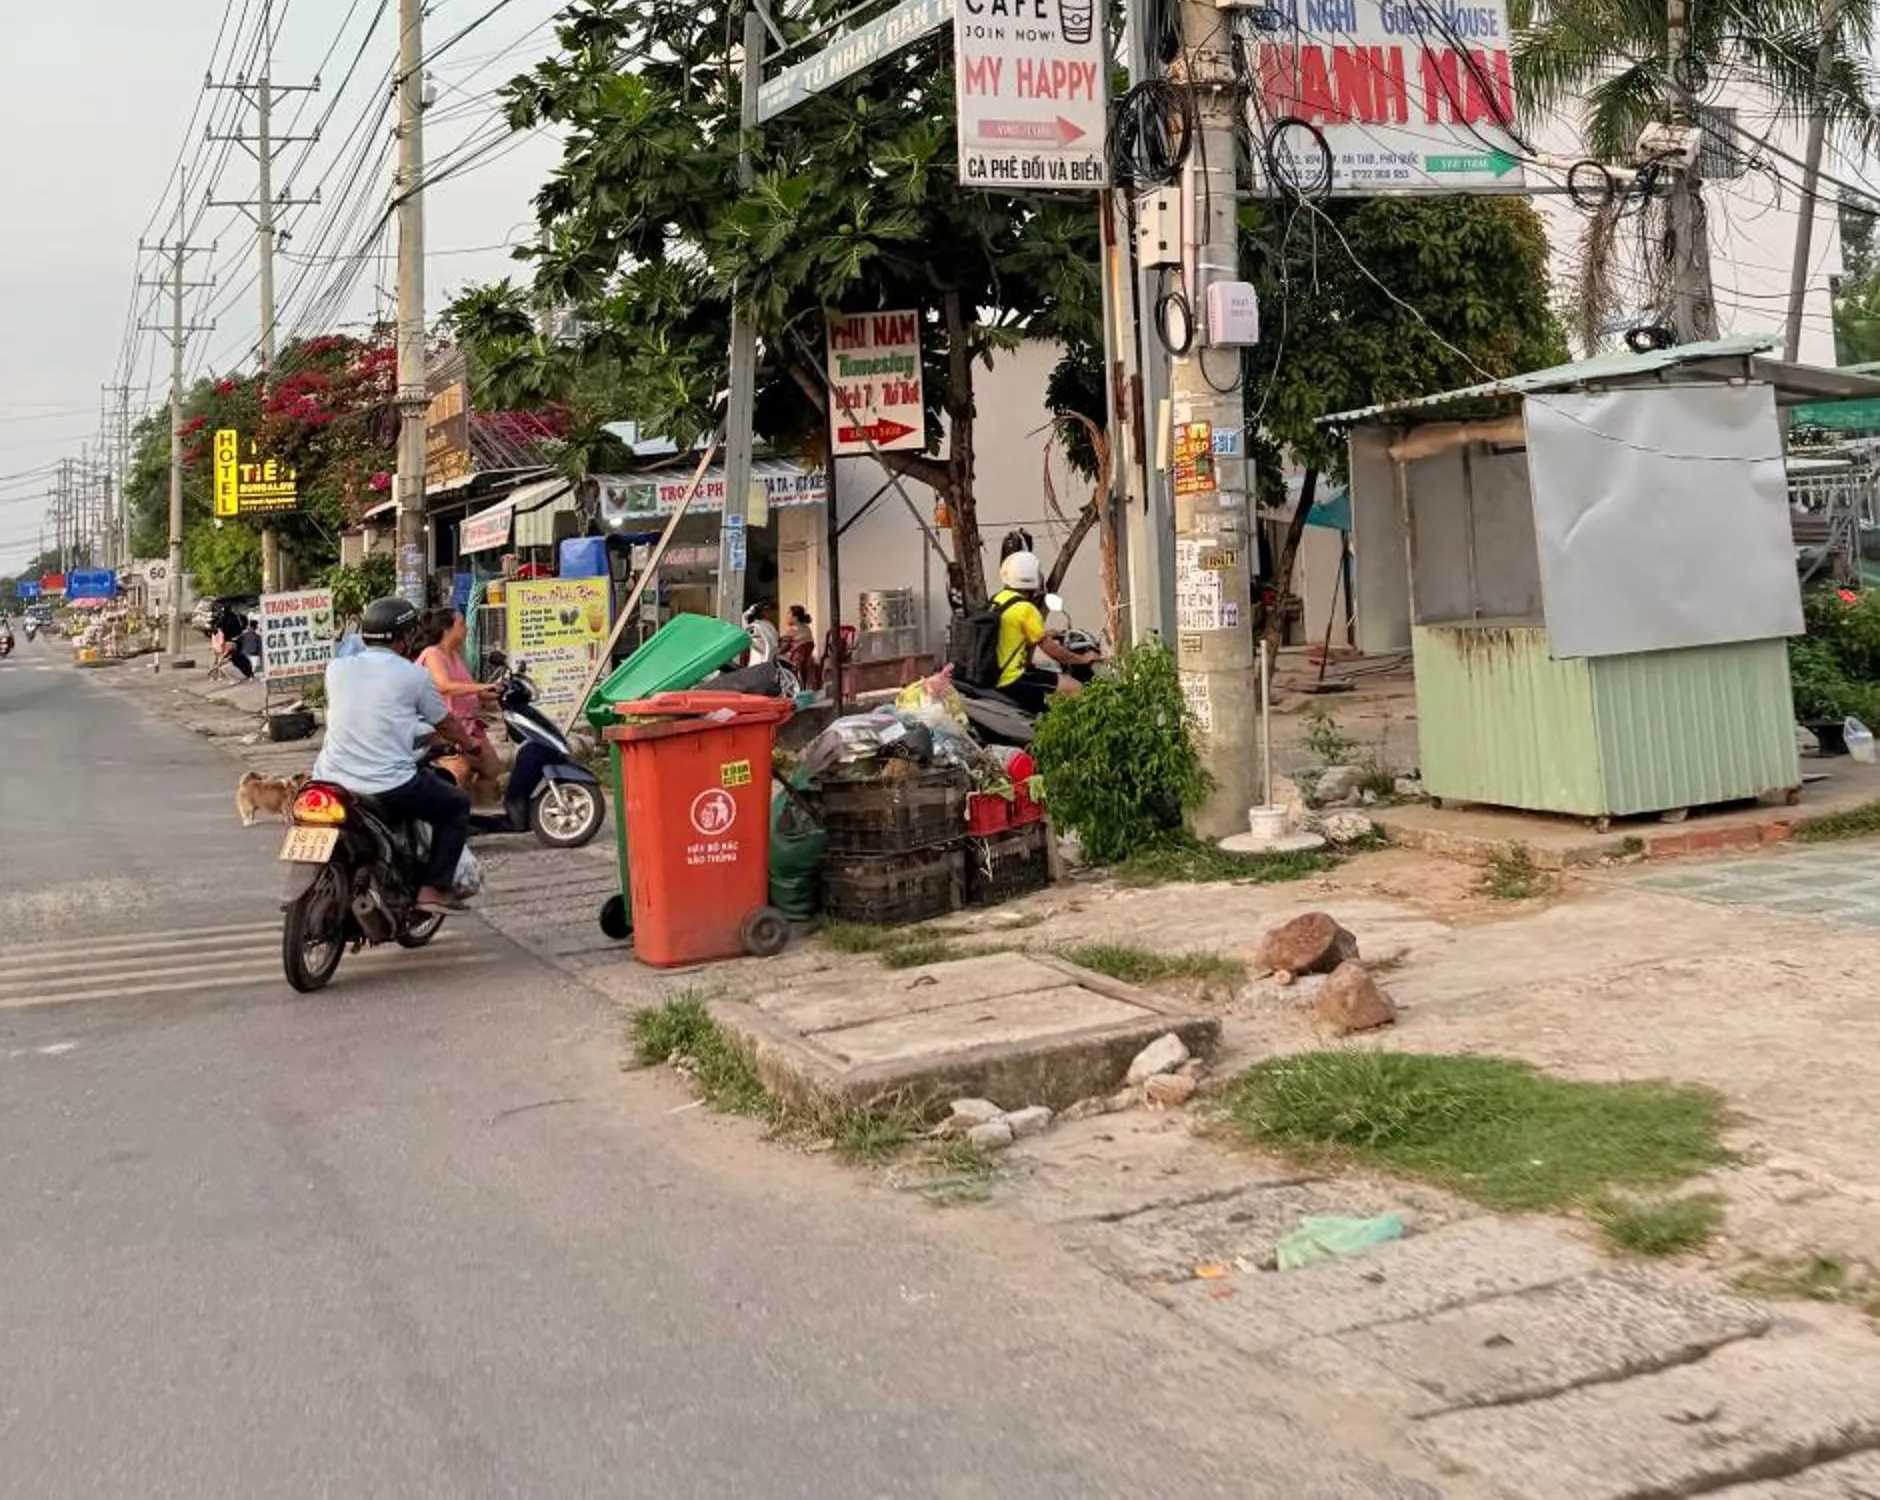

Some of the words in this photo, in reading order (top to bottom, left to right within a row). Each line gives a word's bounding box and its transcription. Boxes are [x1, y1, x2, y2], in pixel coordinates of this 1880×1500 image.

[965, 26, 1005, 40] JOIN
[1016, 29, 1055, 42] NOW!
[965, 55, 1003, 97] MY
[1016, 57, 1098, 101] HAPPY
[1421, 46, 1517, 126] MAI
[968, 154, 987, 179] CÀ
[991, 155, 1019, 179] PHÊ
[1048, 157, 1068, 180] VÀ
[873, 314, 916, 347] NAM
[219, 432, 232, 512] HOTEL
[660, 483, 706, 501] TROG
[149, 567, 166, 580] 60
